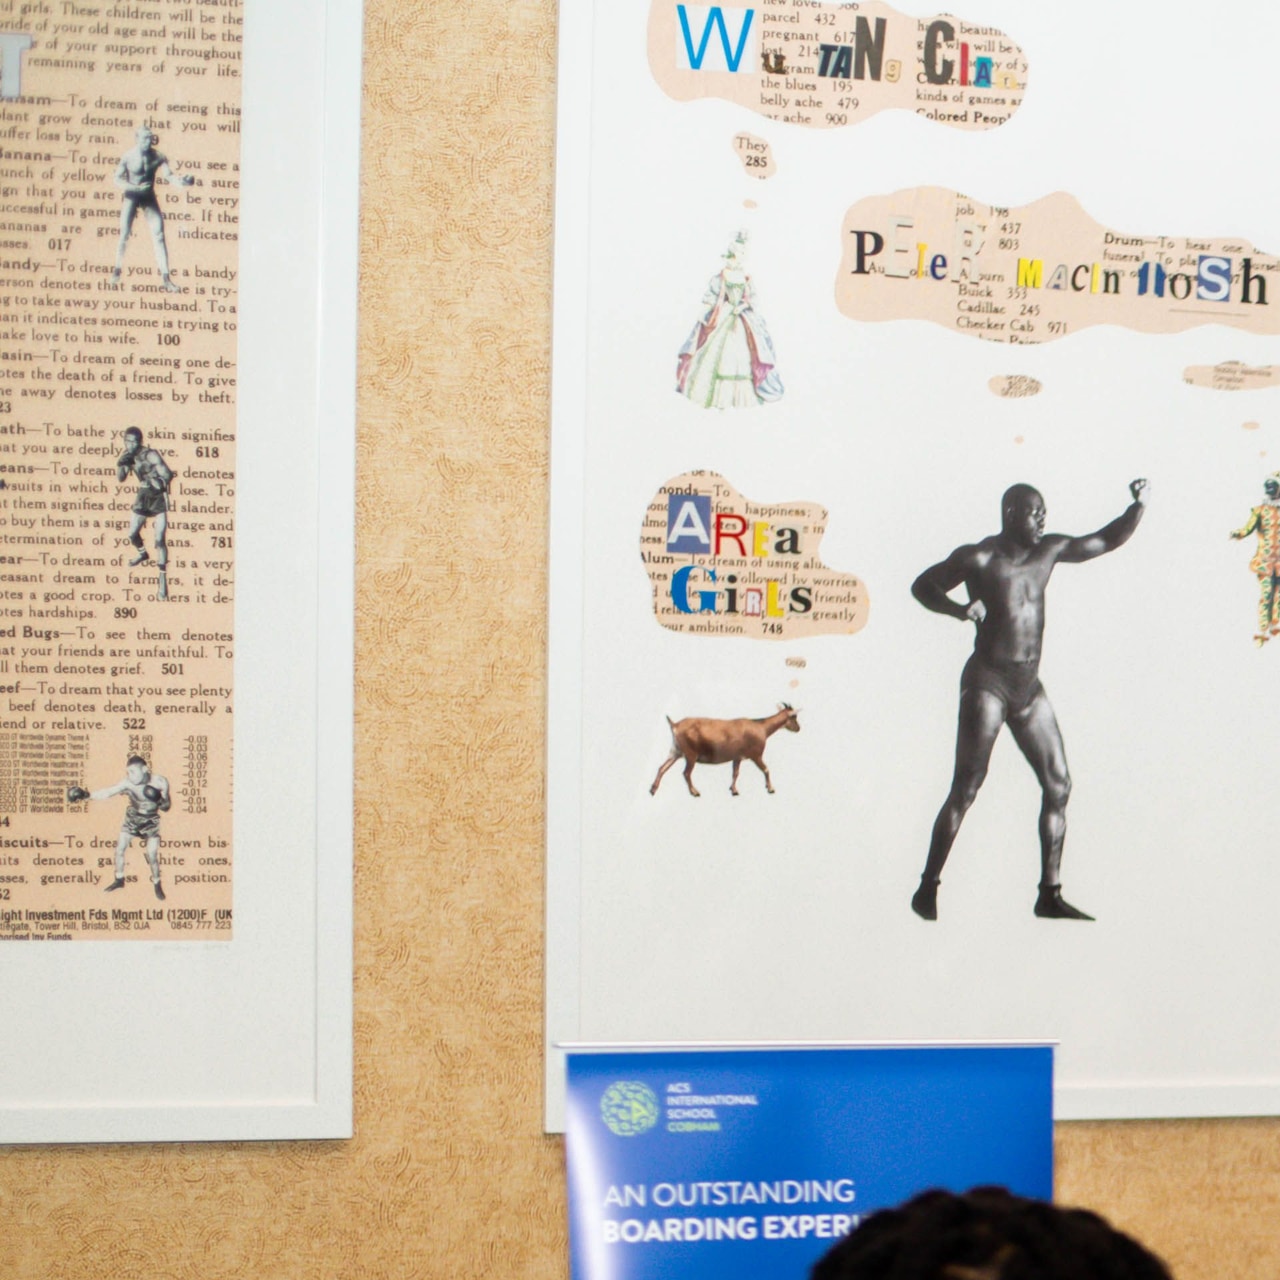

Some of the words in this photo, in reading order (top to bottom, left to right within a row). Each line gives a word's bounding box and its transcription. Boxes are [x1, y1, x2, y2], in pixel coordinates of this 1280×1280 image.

[106, 7, 161, 20] children
[762, 11, 800, 24] parcel
[814, 13, 836, 26] 432
[762, 30, 819, 42] pregnant
[105, 44, 157, 57] support
[166, 44, 241, 61] throughout
[761, 43, 783, 56] lost
[760, 93, 790, 109] belly
[795, 95, 823, 108] ache
[837, 97, 859, 109] 479
[968, 93, 1006, 107] games
[735, 136, 768, 154] They
[746, 155, 767, 168] 285
[958, 283, 993, 297] Buick
[140, 297, 202, 312] husband.
[957, 300, 1005, 314] Cadillac
[1020, 304, 1040, 316] 245
[956, 316, 1005, 330] Checker
[1009, 319, 1034, 332] Cab
[1047, 321, 1067, 334] 971
[157, 333, 181, 346] 100
[57, 367, 95, 381] death
[745, 503, 811, 520] happiness;
[812, 578, 857, 587] worries
[28, 605, 98, 620] hardships.
[114, 607, 137, 619] 890
[688, 622, 747, 635] ambition.
[762, 623, 783, 634] 748
[135, 645, 209, 659] unfaithful.
[161, 663, 184, 675] 501
[190, 683, 232, 699] plenty
[155, 701, 216, 716] generally
[51, 717, 106, 730] relative.
[123, 718, 146, 730] 522
[25, 909, 86, 921] Investment
[89, 909, 108, 921] Fds
[111, 909, 143, 922] Mgmt
[146, 909, 163, 920] Ltd
[666, 1082, 691, 1094] ACS
[666, 1094, 759, 1107] INTERNATIONAL
[666, 1108, 717, 1120] SCHOOL
[666, 1121, 721, 1133] COBHAM
[603, 1183, 647, 1208] AN
[652, 1178, 856, 1207] OUTSTANDING
[603, 1216, 758, 1244] BOARDING
